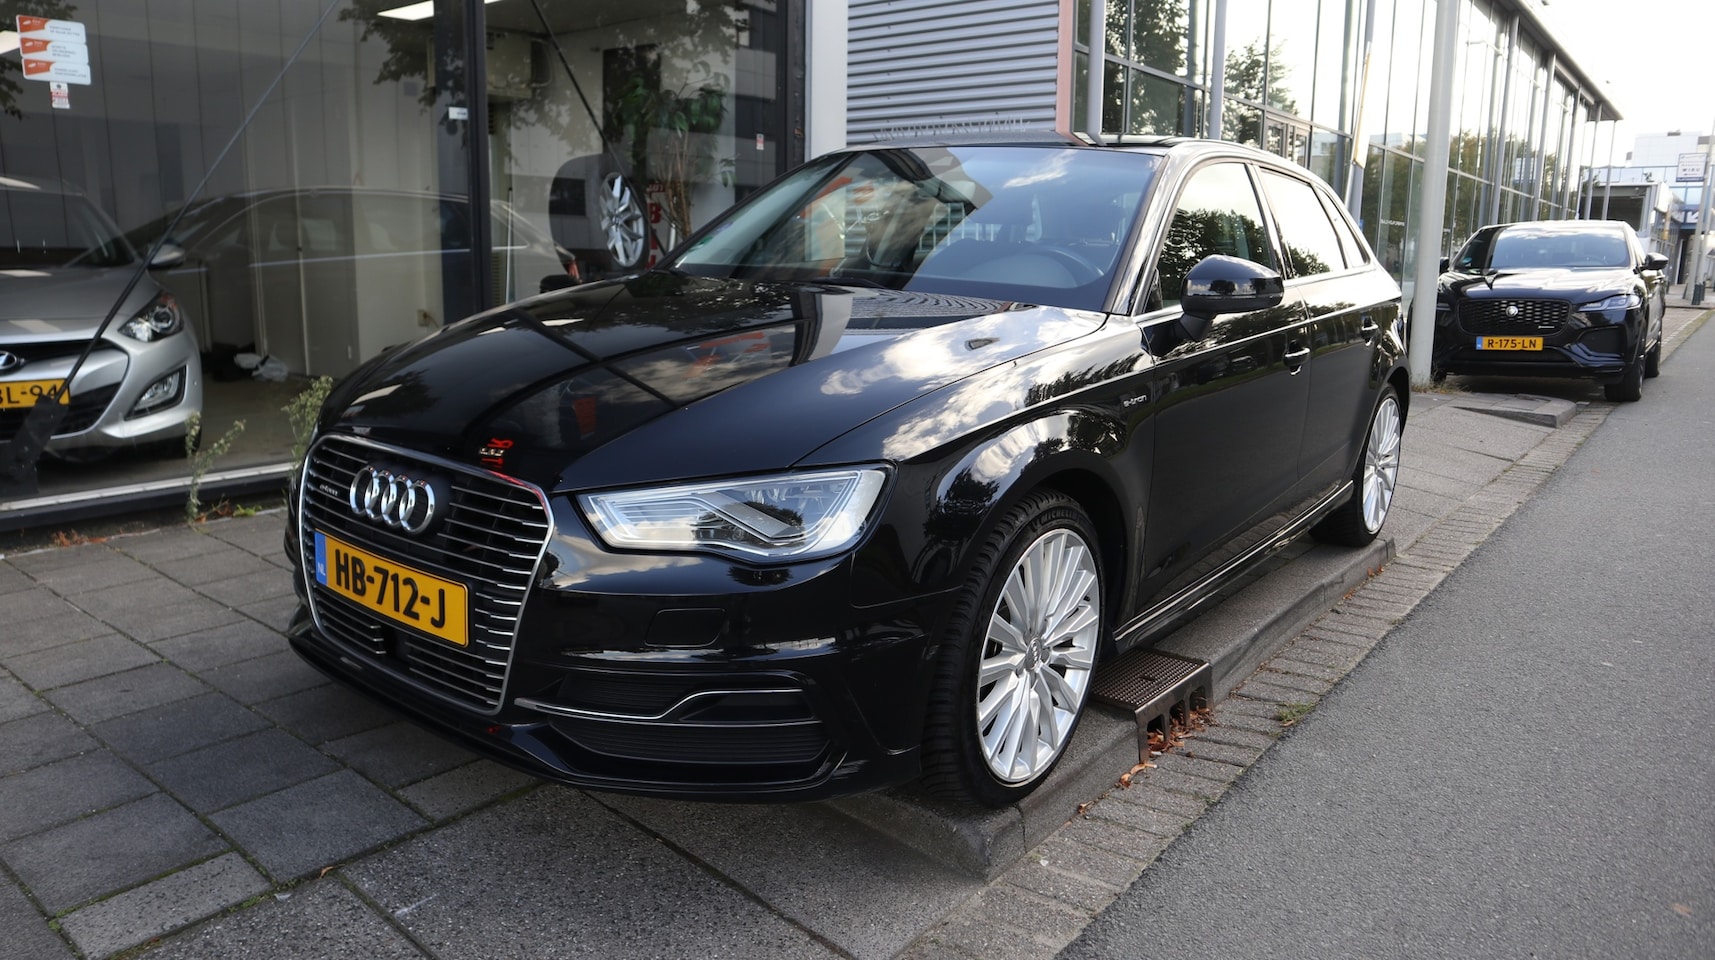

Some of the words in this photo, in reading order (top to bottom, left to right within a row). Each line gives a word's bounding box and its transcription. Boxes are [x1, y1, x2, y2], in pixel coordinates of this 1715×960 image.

[1487, 339, 1537, 348] R-175-LN
[317, 561, 326, 576] NL
[335, 549, 446, 629] HB-712-J
